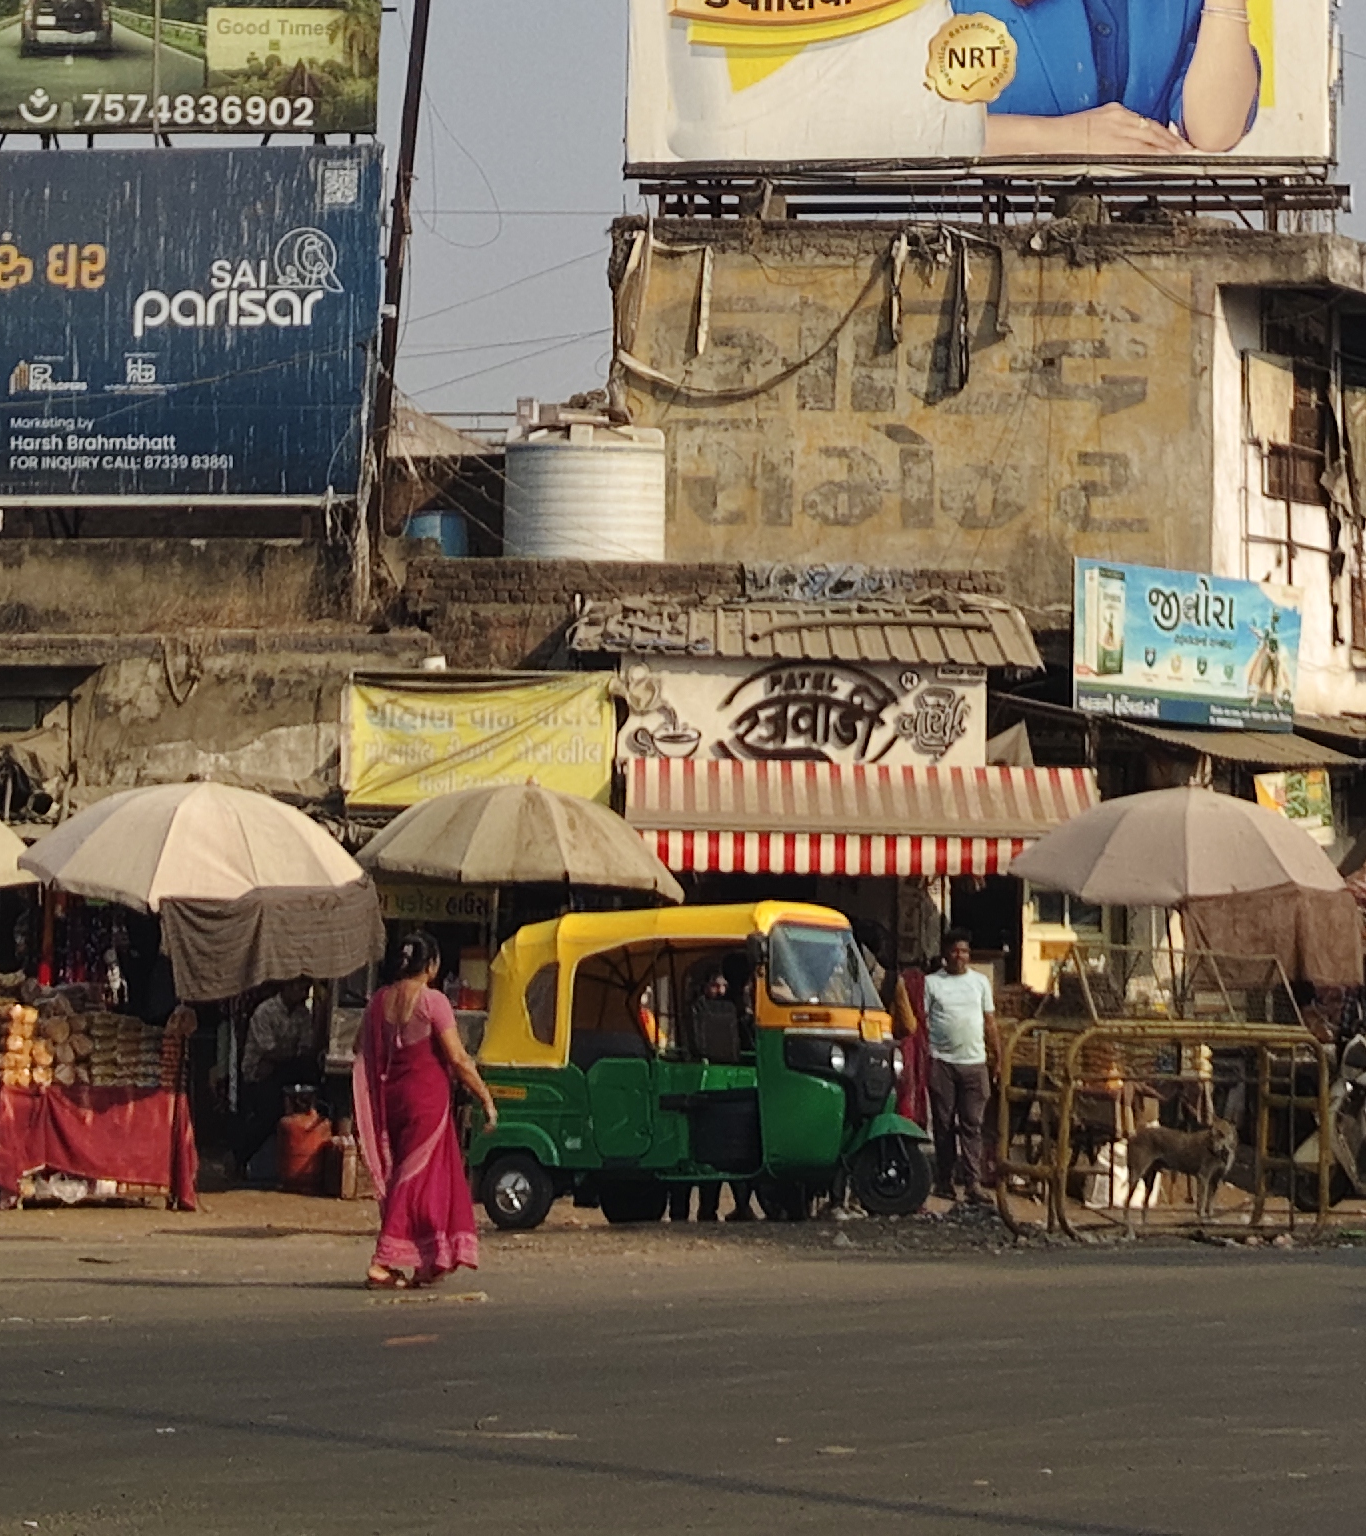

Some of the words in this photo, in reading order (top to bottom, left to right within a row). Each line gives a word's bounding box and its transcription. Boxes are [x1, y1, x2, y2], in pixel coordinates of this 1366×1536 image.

[217, 17, 270, 35] Good
[948, 46, 1002, 69] NRT
[82, 93, 314, 126] 7574836902
[46, 243, 107, 291] ઘર
[211, 260, 267, 288] SAI
[134, 287, 324, 337] parisar
[10, 417, 75, 431] Marketing
[77, 417, 96, 432] by
[10, 435, 63, 451] Harsh
[67, 434, 176, 451] Brahmbhatt
[10, 456, 38, 470] FOR
[41, 456, 99, 471] INQUIRY
[102, 456, 141, 470] CALL:
[766, 671, 838, 694] PATEL
